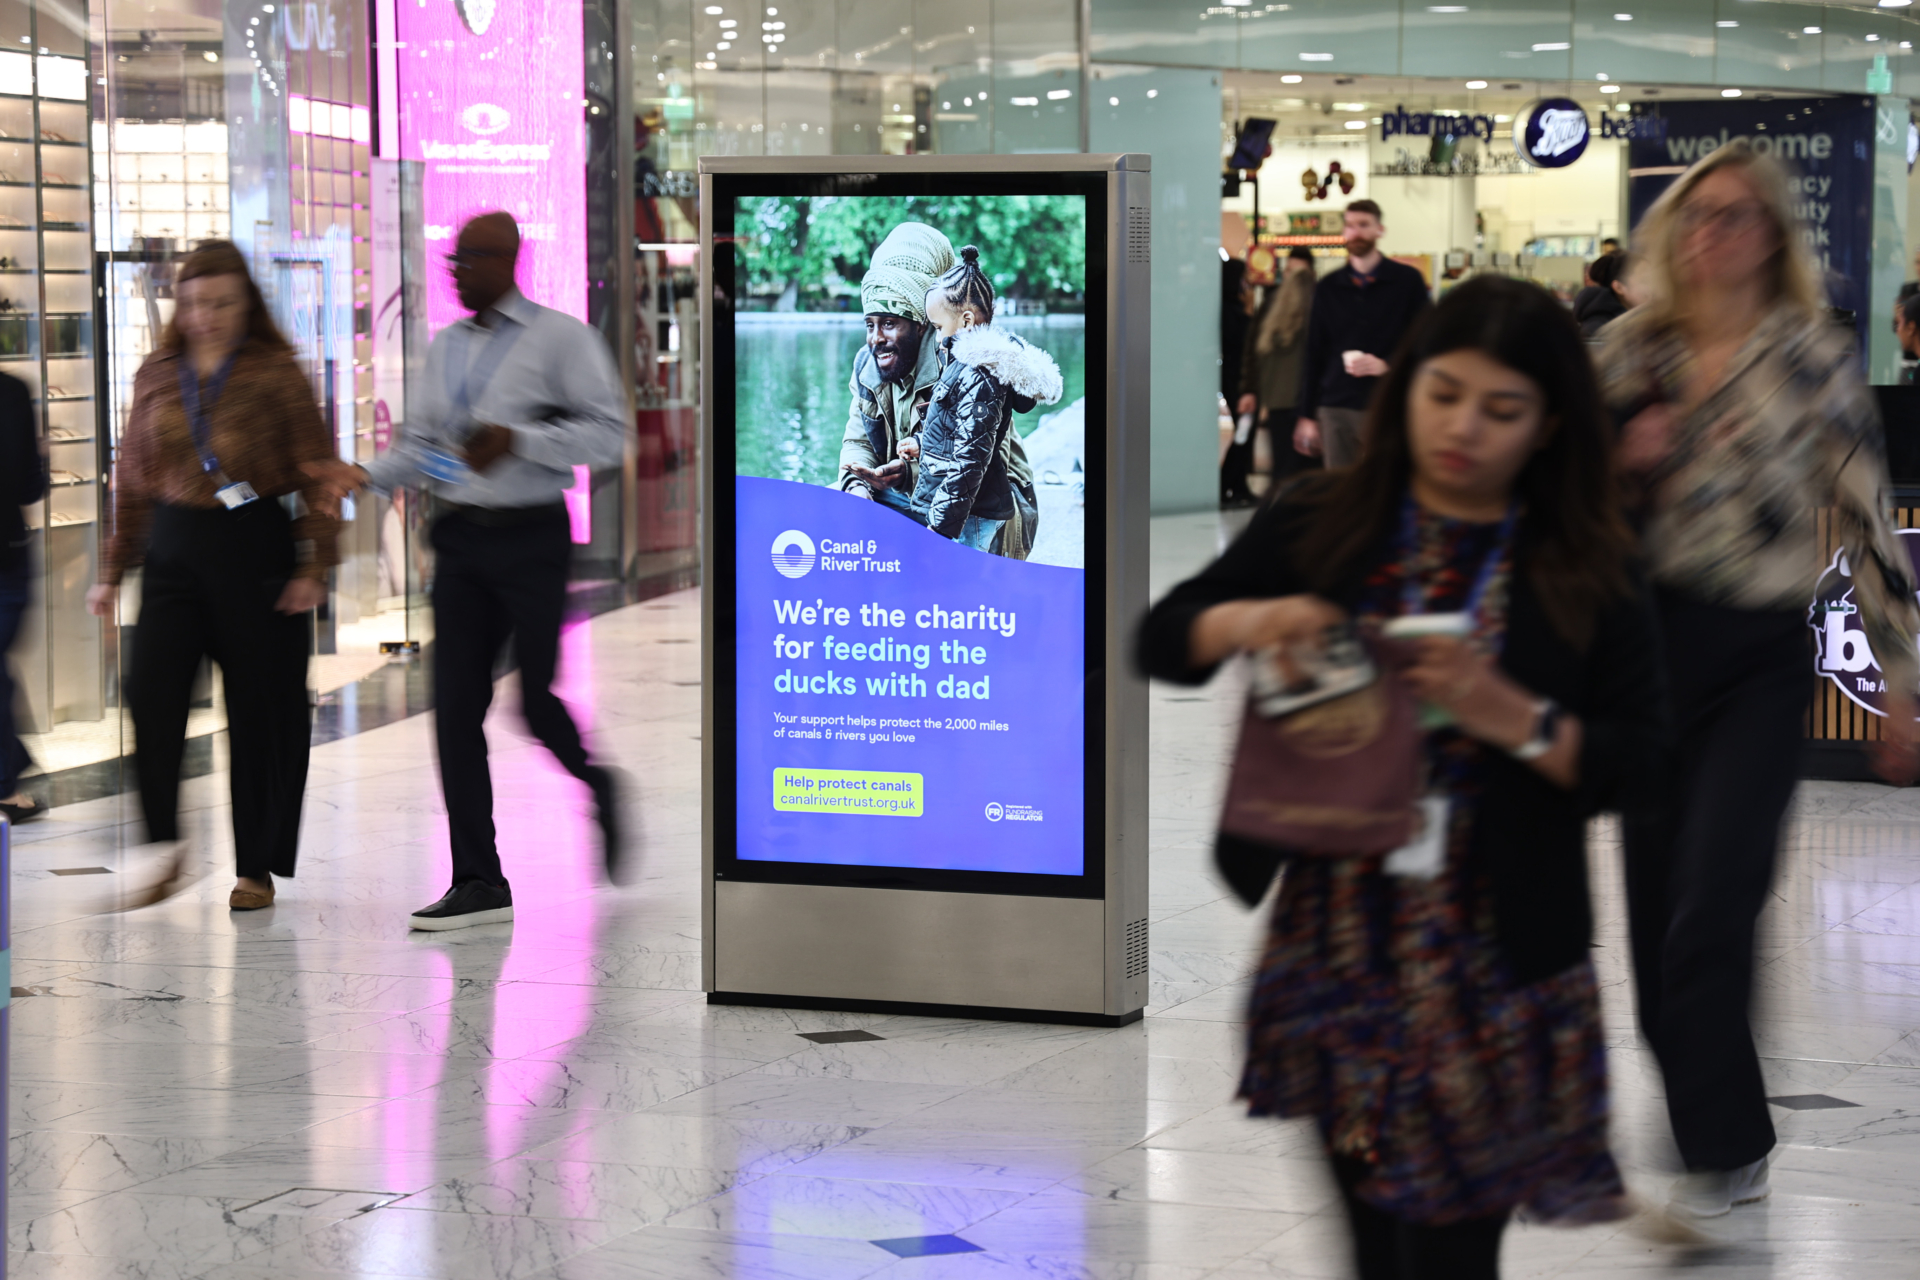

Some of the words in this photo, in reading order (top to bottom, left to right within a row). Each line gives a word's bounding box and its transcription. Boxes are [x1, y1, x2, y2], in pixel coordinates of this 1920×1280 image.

[1381, 105, 1497, 143] pharmacy
[820, 538, 863, 554] Canal
[867, 540, 878, 555] &
[821, 556, 860, 572] River
[861, 557, 901, 573] Trust
[860, 602, 906, 628] the
[915, 604, 1016, 637] charity
[773, 633, 815, 660] for
[823, 635, 930, 669] feeding
[940, 639, 987, 665] the
[774, 669, 857, 696] ducks
[866, 672, 927, 698] with
[936, 674, 990, 700] dad
[1856, 677, 1877, 693] The
[773, 711, 798, 725] Your
[800, 713, 844, 729] support
[846, 714, 877, 729] helps
[879, 716, 921, 731] protect
[923, 717, 943, 730] the
[944, 718, 977, 732] 2,000
[979, 719, 1010, 732] miles
[773, 727, 785, 739] of
[787, 728, 822, 740] canals
[824, 729, 832, 740] &
[835, 730, 866, 741] rivers
[868, 733, 890, 744] you
[892, 731, 916, 743] love
[784, 774, 815, 792] Help
[818, 777, 867, 793] protect
[870, 779, 912, 793] canals
[780, 793, 916, 811] canalrivertrust.org.uk
[988, 808, 1001, 816] FR
